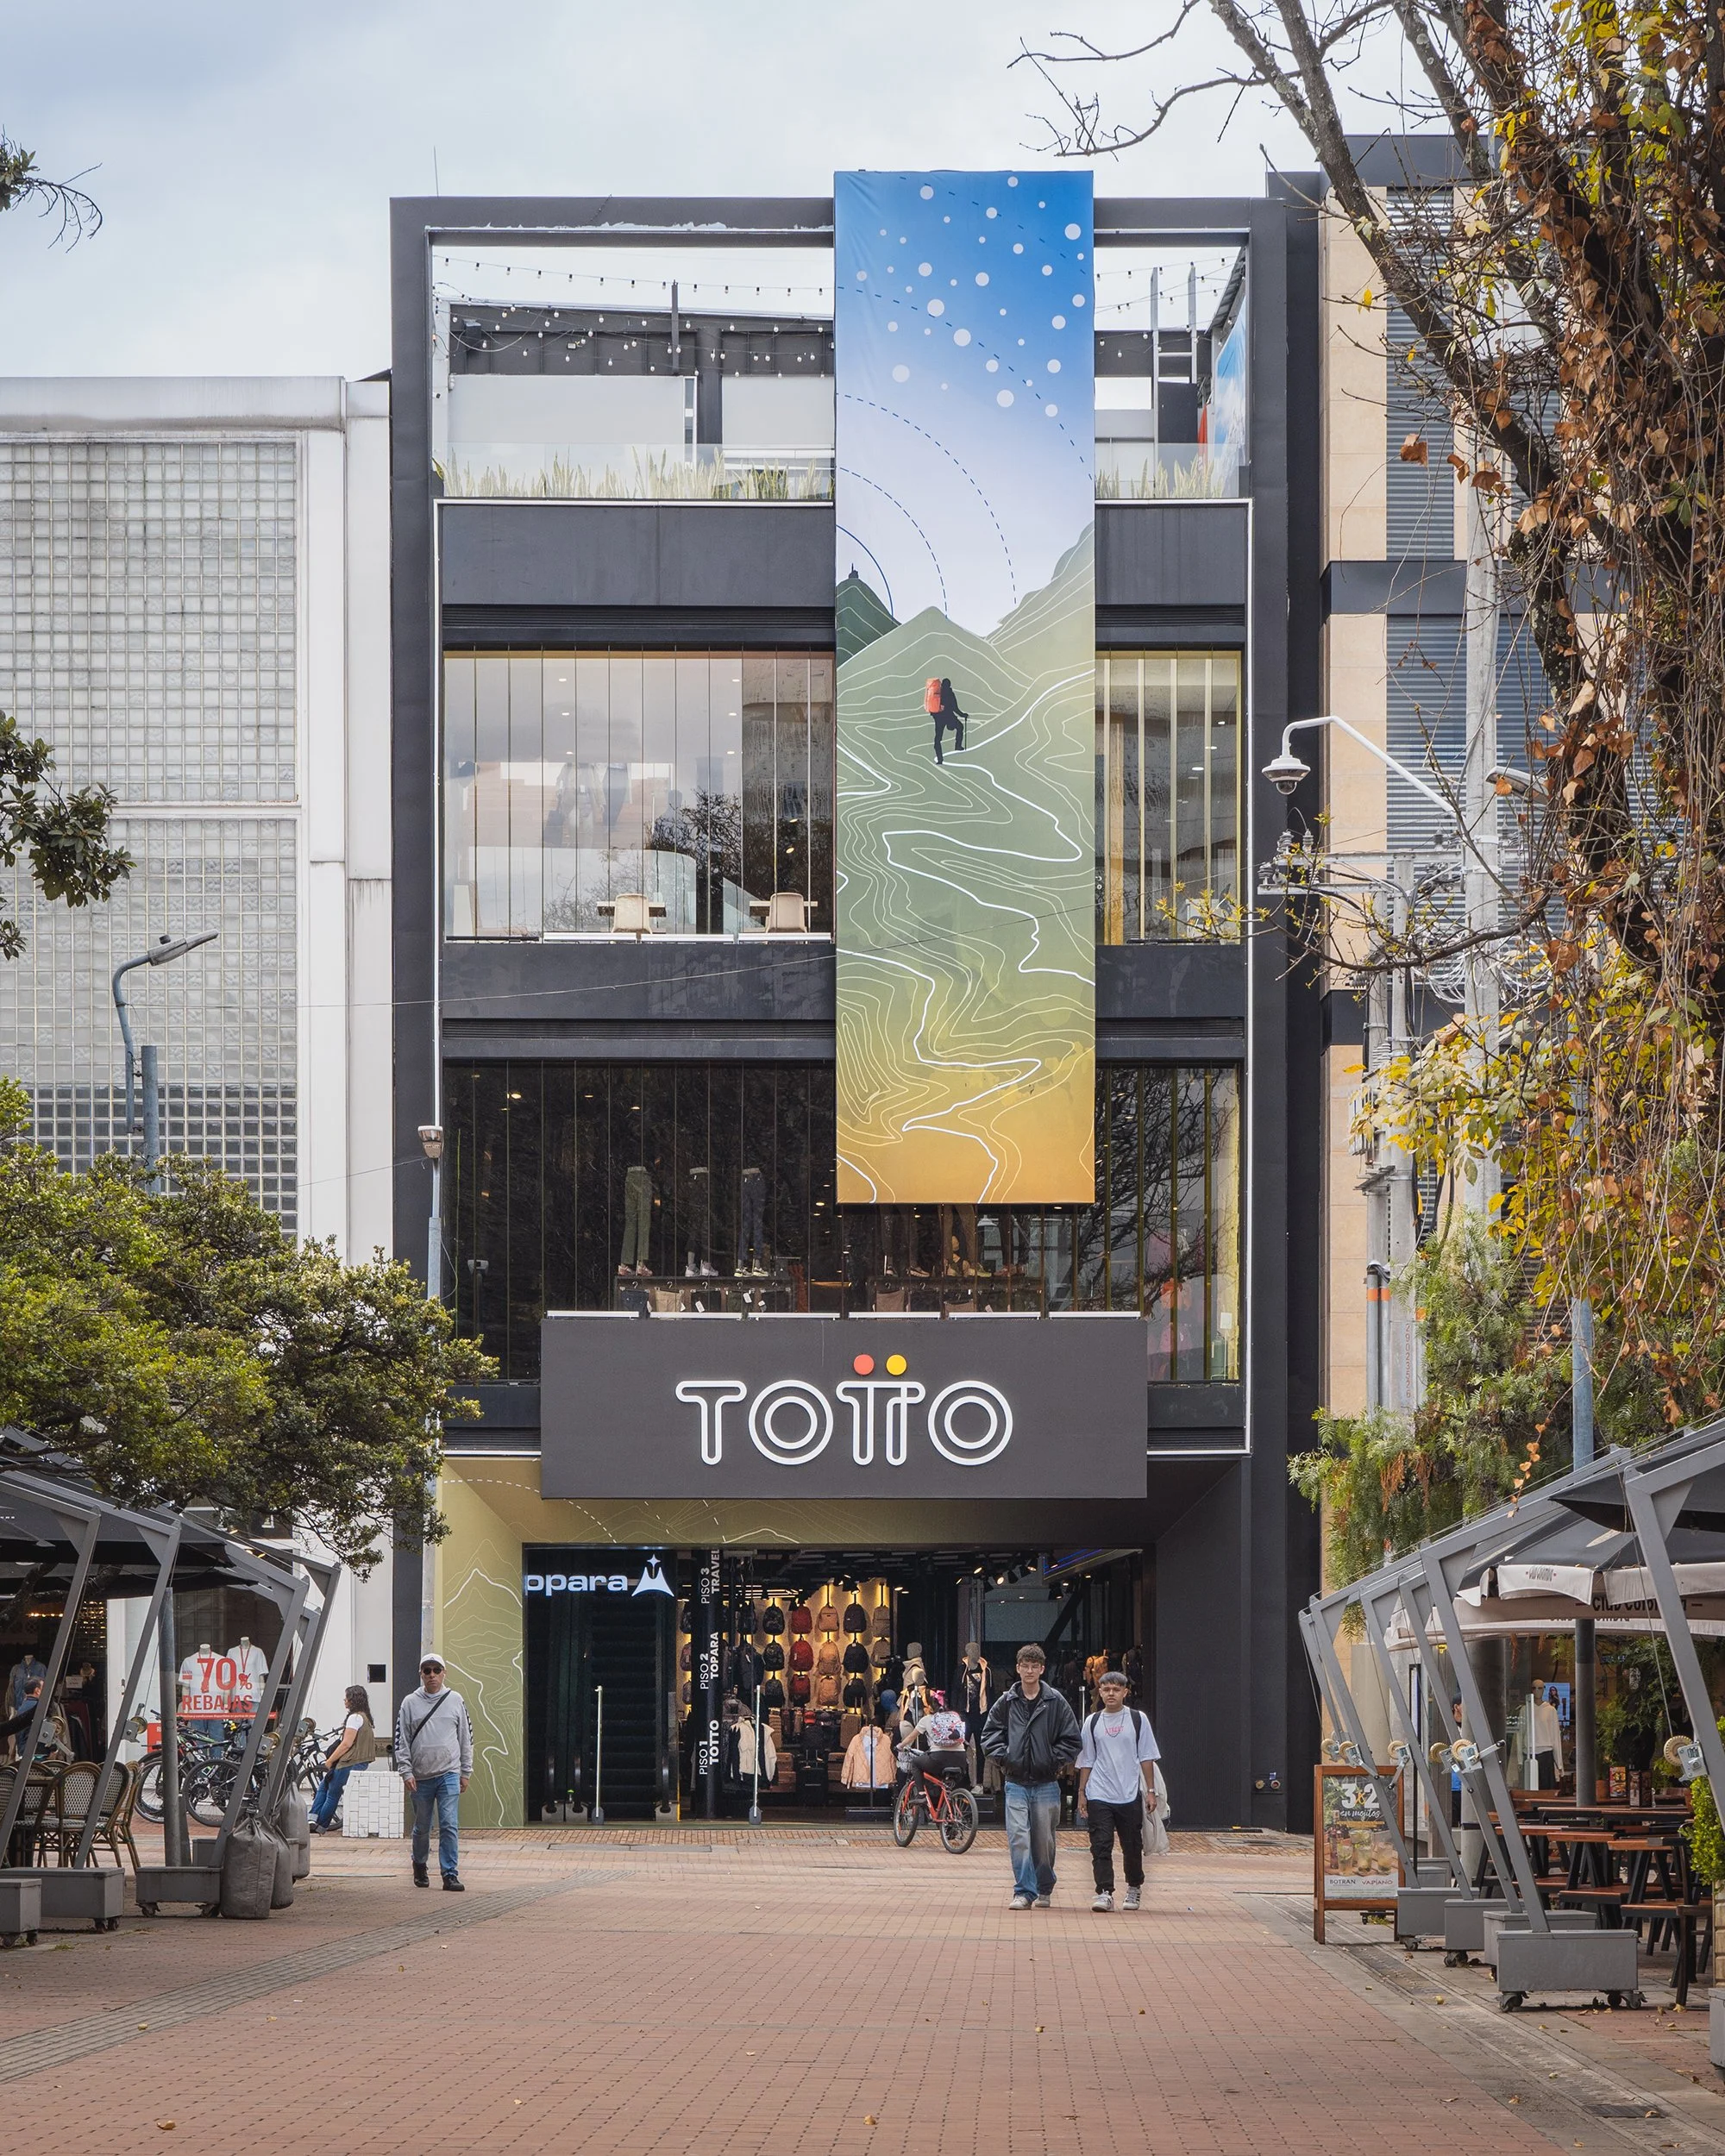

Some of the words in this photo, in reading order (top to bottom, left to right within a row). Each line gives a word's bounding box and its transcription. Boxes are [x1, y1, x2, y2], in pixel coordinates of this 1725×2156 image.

[675, 1379, 1013, 1465] TOTTO
[700, 1567, 710, 1576] 3
[711, 1549, 720, 1594] TRAVEL
[700, 1577, 710, 1604] PISO
[710, 1632, 719, 1680] TOPARA
[699, 1663, 709, 1689] PISO
[182, 1695, 254, 1710] REBAJAS
[709, 1720, 719, 1765] TOTTO
[699, 1748, 708, 1775] PISO
[1352, 1808, 1381, 1821] mojitos
